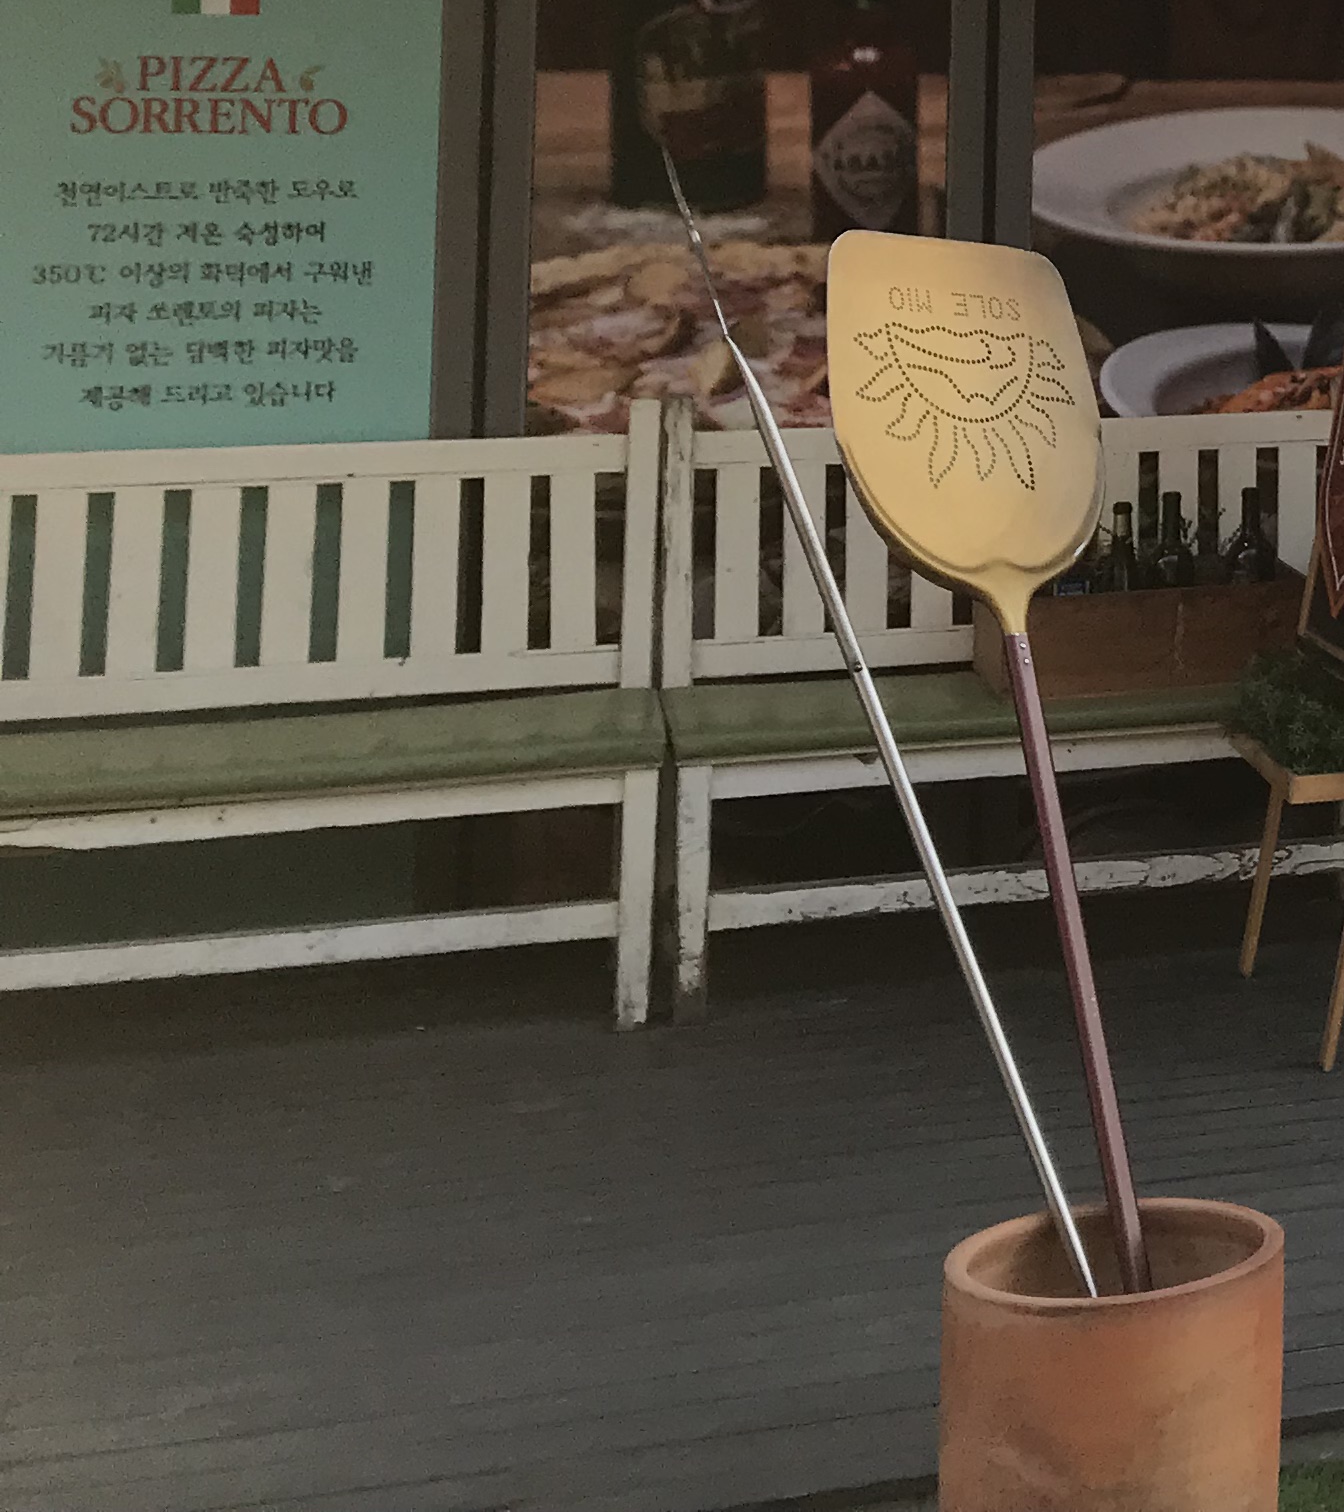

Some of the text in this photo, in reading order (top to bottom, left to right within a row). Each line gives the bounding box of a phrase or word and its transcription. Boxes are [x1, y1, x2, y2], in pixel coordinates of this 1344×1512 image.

[137, 55, 286, 93] PIZZA
[69, 97, 348, 136] SORRENTO
[87, 221, 327, 246] 72시간 저온 숙성하여
[118, 261, 190, 287] 이상의
[199, 261, 293, 283] 화덕에서
[88, 302, 138, 324] 피자
[252, 300, 323, 324] 피자는
[888, 286, 1021, 322] SOLE MIO
[243, 380, 336, 406] 있습니다
